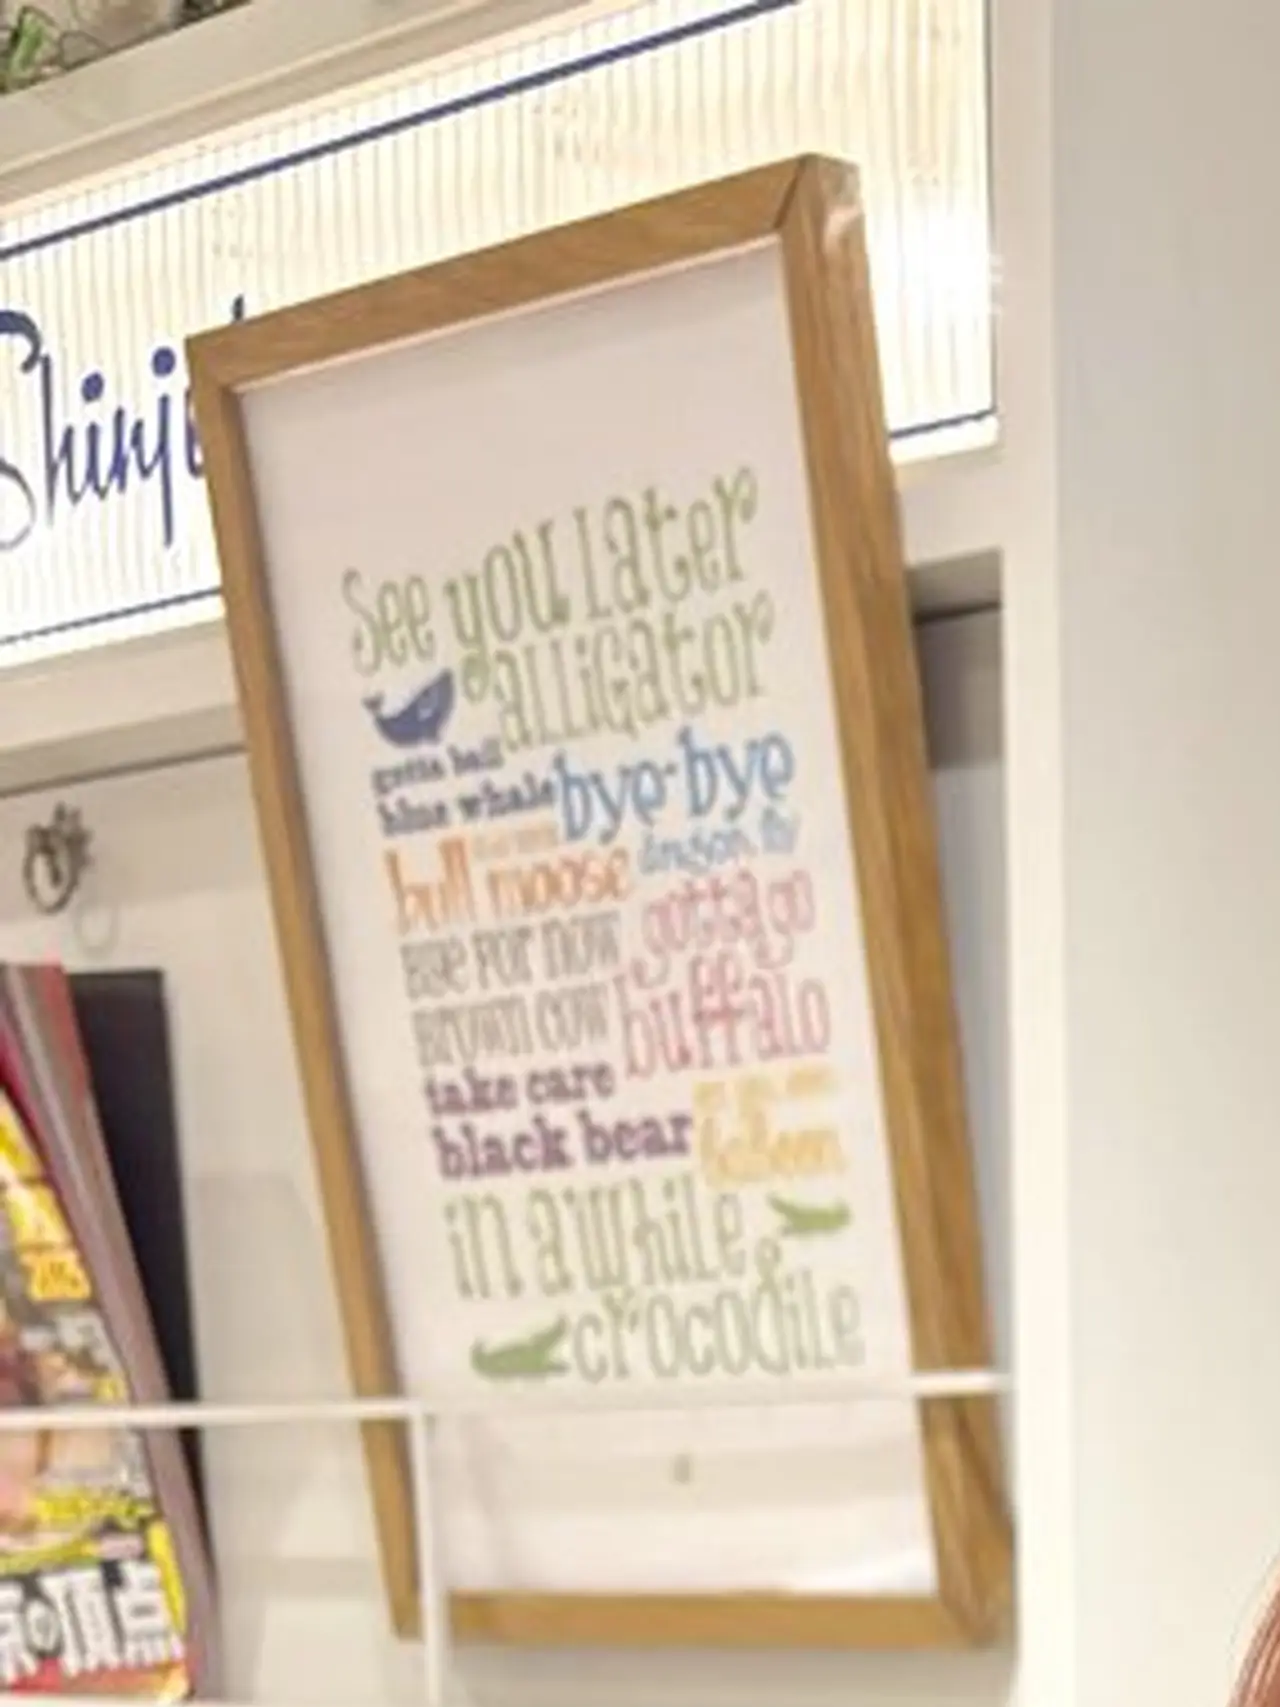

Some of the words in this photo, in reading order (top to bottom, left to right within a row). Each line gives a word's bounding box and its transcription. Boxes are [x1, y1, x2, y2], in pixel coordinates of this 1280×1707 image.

[342, 567, 436, 676] See
[442, 519, 571, 706] you
[457, 773, 556, 820] whale
[552, 725, 797, 845] bye-bye
[487, 846, 632, 922] moose
[611, 948, 833, 1080] buffalo
[424, 1066, 518, 1116] take
[525, 1060, 615, 1105] care
[431, 1115, 575, 1180] black
[577, 1109, 694, 1164] bear
[444, 1192, 525, 1300] in
